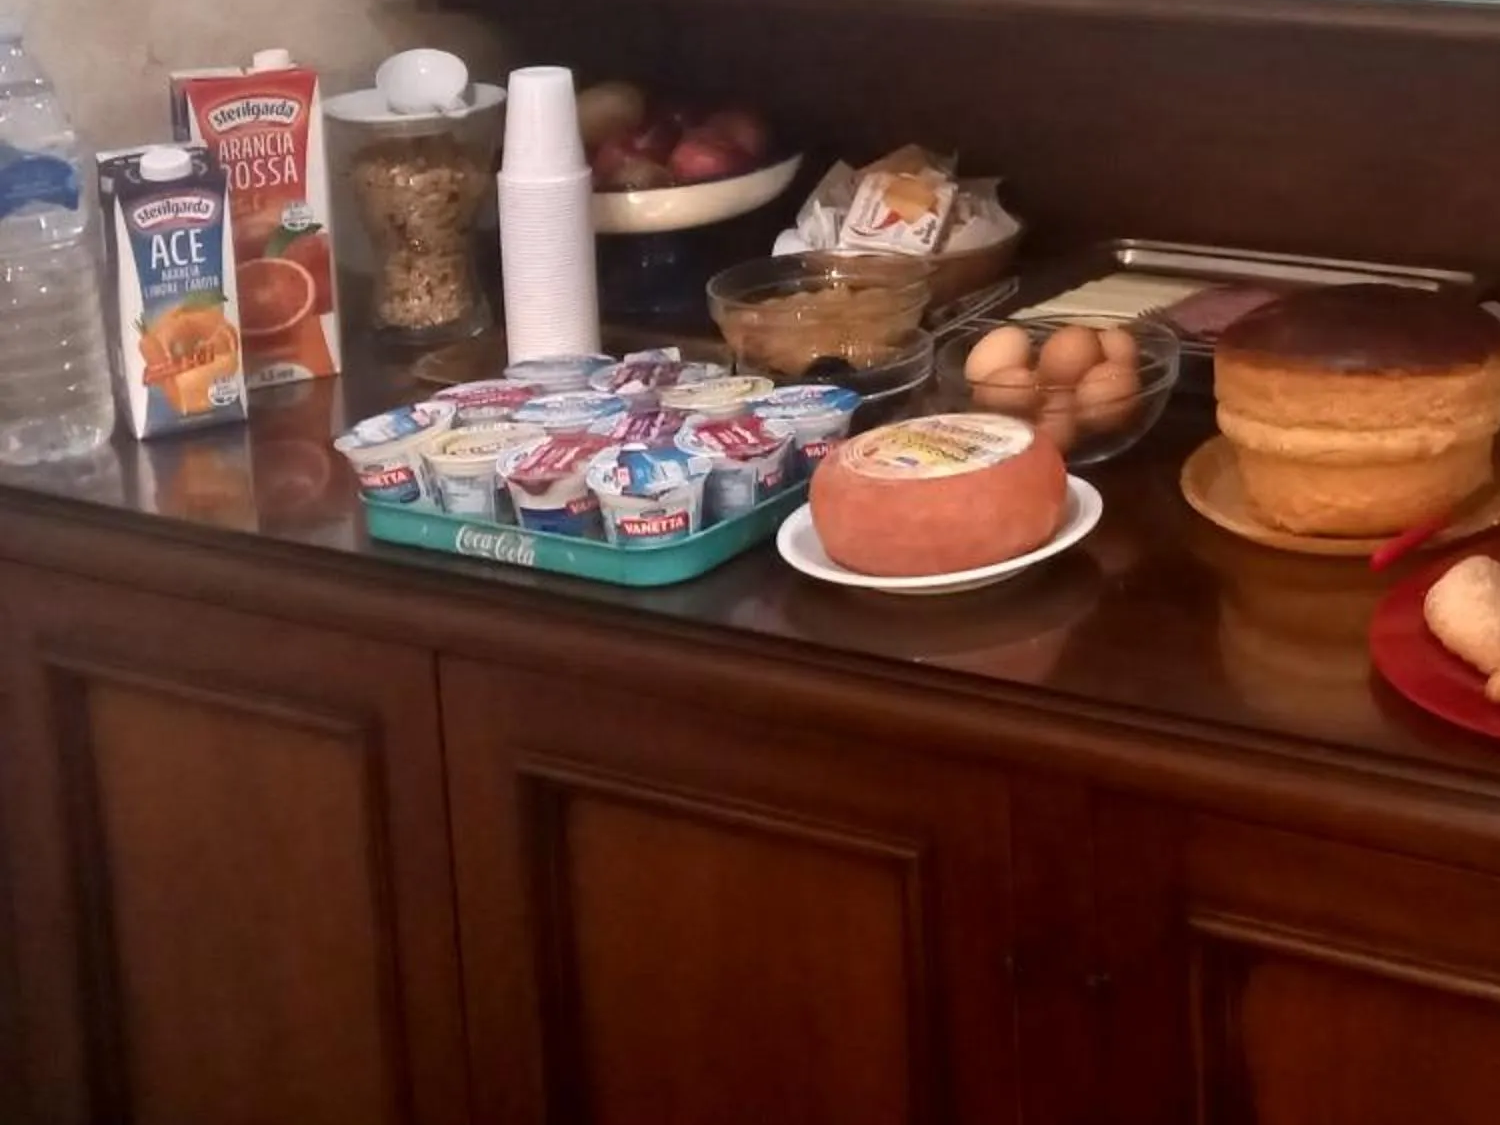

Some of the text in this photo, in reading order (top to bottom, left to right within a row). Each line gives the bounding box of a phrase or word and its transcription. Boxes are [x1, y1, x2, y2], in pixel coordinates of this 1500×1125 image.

[213, 100, 295, 126] sterilgarda
[219, 131, 295, 161] ARANCIA
[137, 199, 210, 224] sterilgarda
[151, 228, 207, 269] ACE
[623, 515, 686, 535] VANETTA
